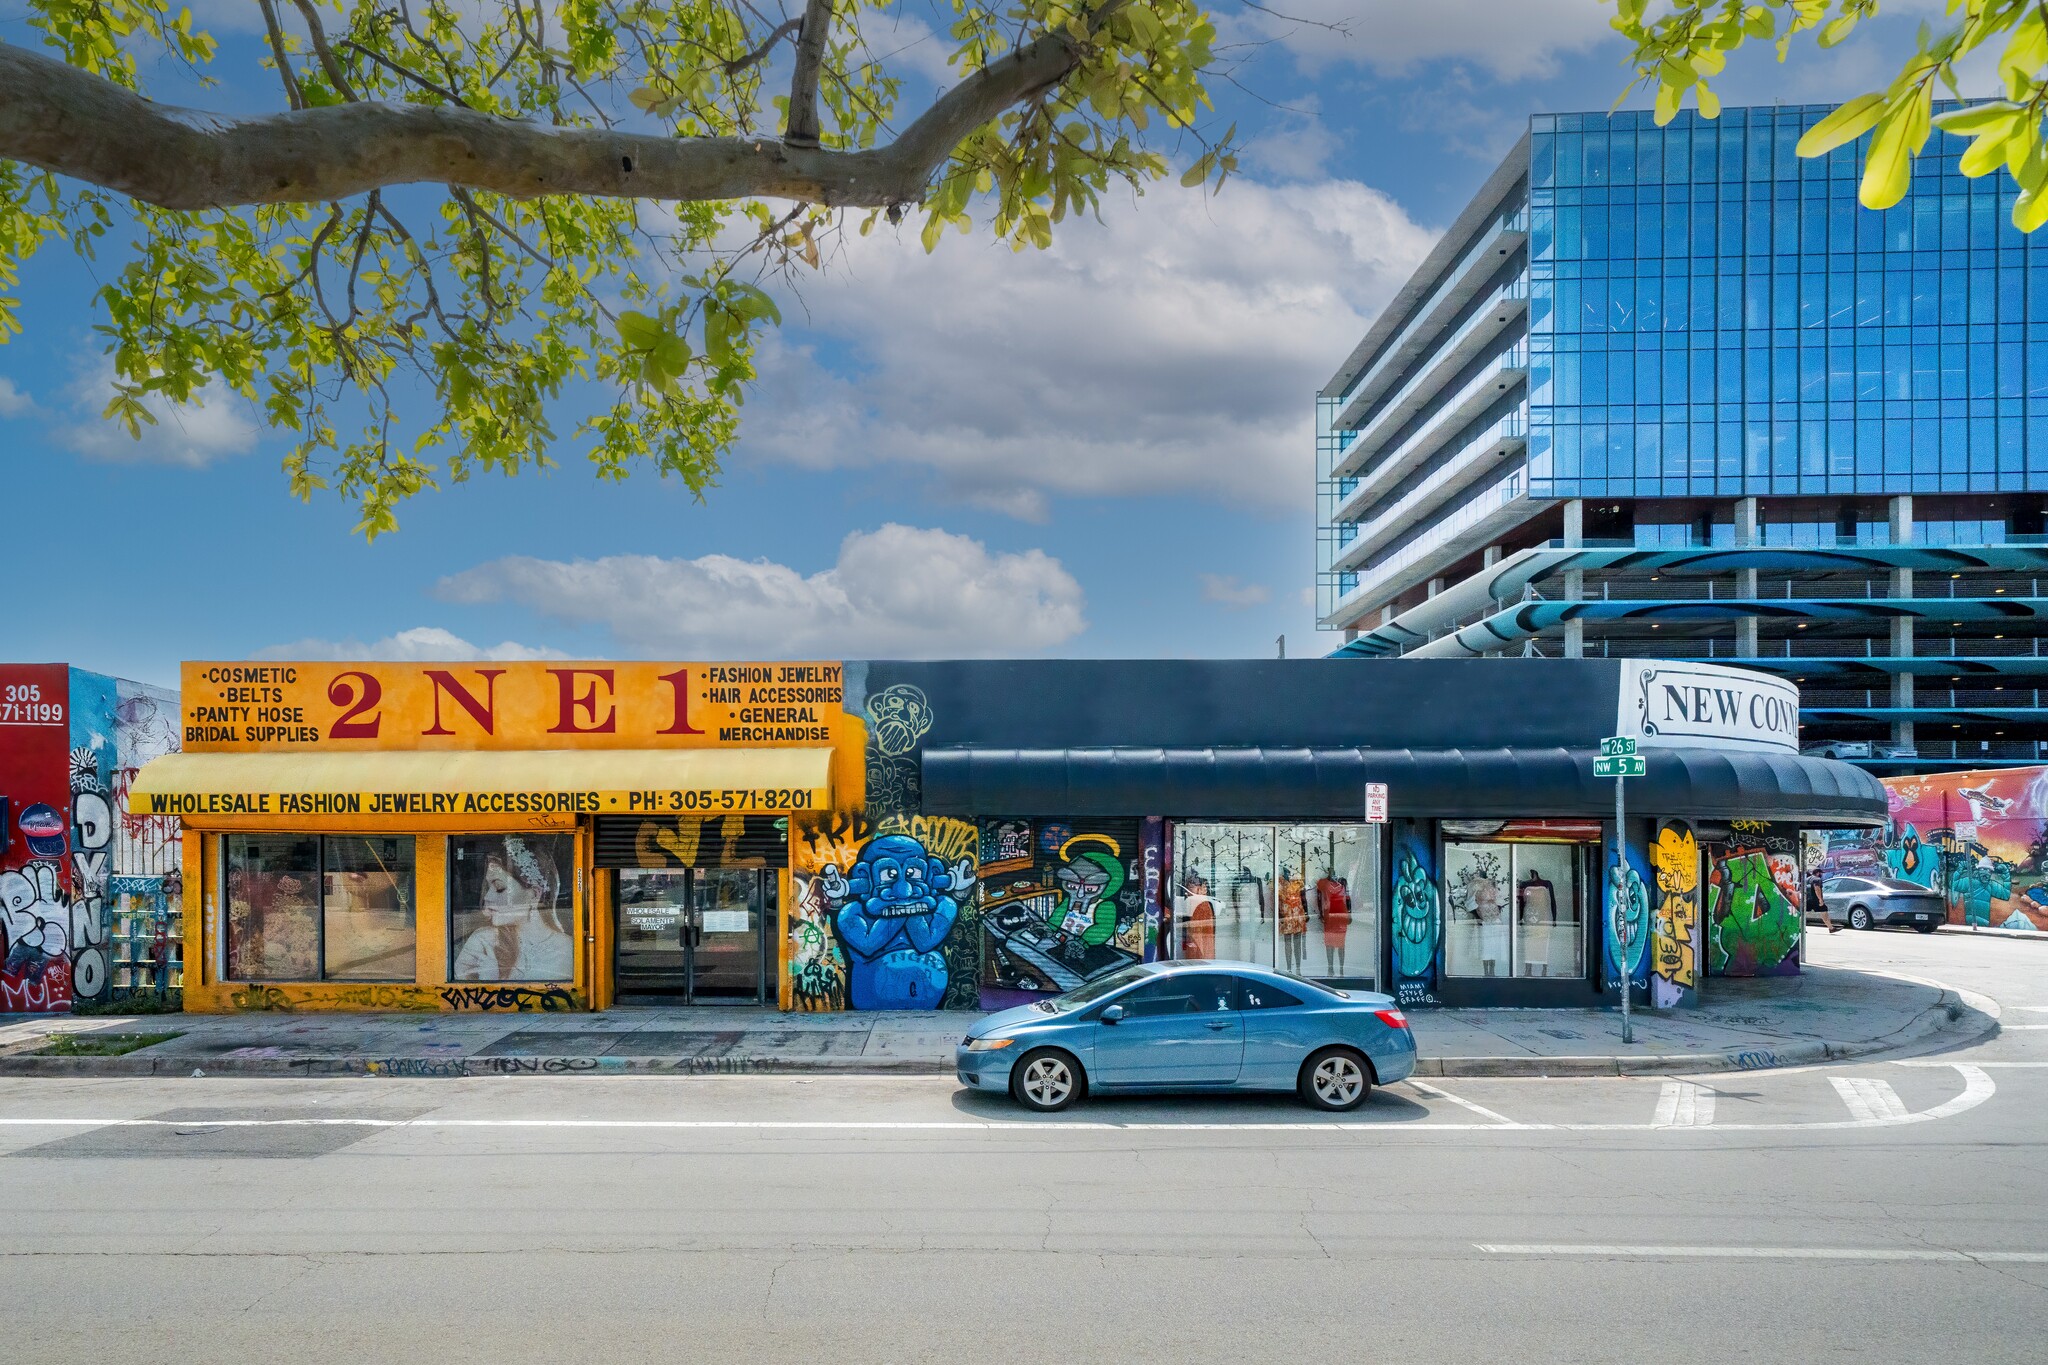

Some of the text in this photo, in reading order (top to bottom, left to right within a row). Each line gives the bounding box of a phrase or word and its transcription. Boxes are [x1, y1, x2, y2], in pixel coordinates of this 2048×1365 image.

[209, 668, 297, 684] COSMETIC
[710, 666, 842, 684] FASHION JEWELRY
[5, 684, 41, 702] 305
[227, 687, 283, 703] BELTS
[710, 687, 842, 704] HAIR ACCESSORIES
[327, 668, 705, 739] 2 N E 1
[1662, 684, 1743, 726] NEW
[0, 703, 63, 721] 71-1199
[196, 706, 304, 723] PANTY HOSE
[739, 707, 819, 723] GENERAL
[185, 726, 320, 743] BRIDAL SUPPLIES
[719, 726, 830, 741] MERCHANDISE
[1611, 739, 1624, 755] 26
[1626, 740, 1635, 752] ST
[1596, 758, 1644, 774] NW 5 AV
[1372, 785, 1380, 793] NO
[151, 789, 812, 814] WHOLESALE FASHION JEWELRY ACCESSORIES PH: 305-571-8201
[626, 907, 670, 915] WHOLESALE
[630, 917, 675, 925] SOLAMENTE
[1398, 989, 1424, 998] STYLE
